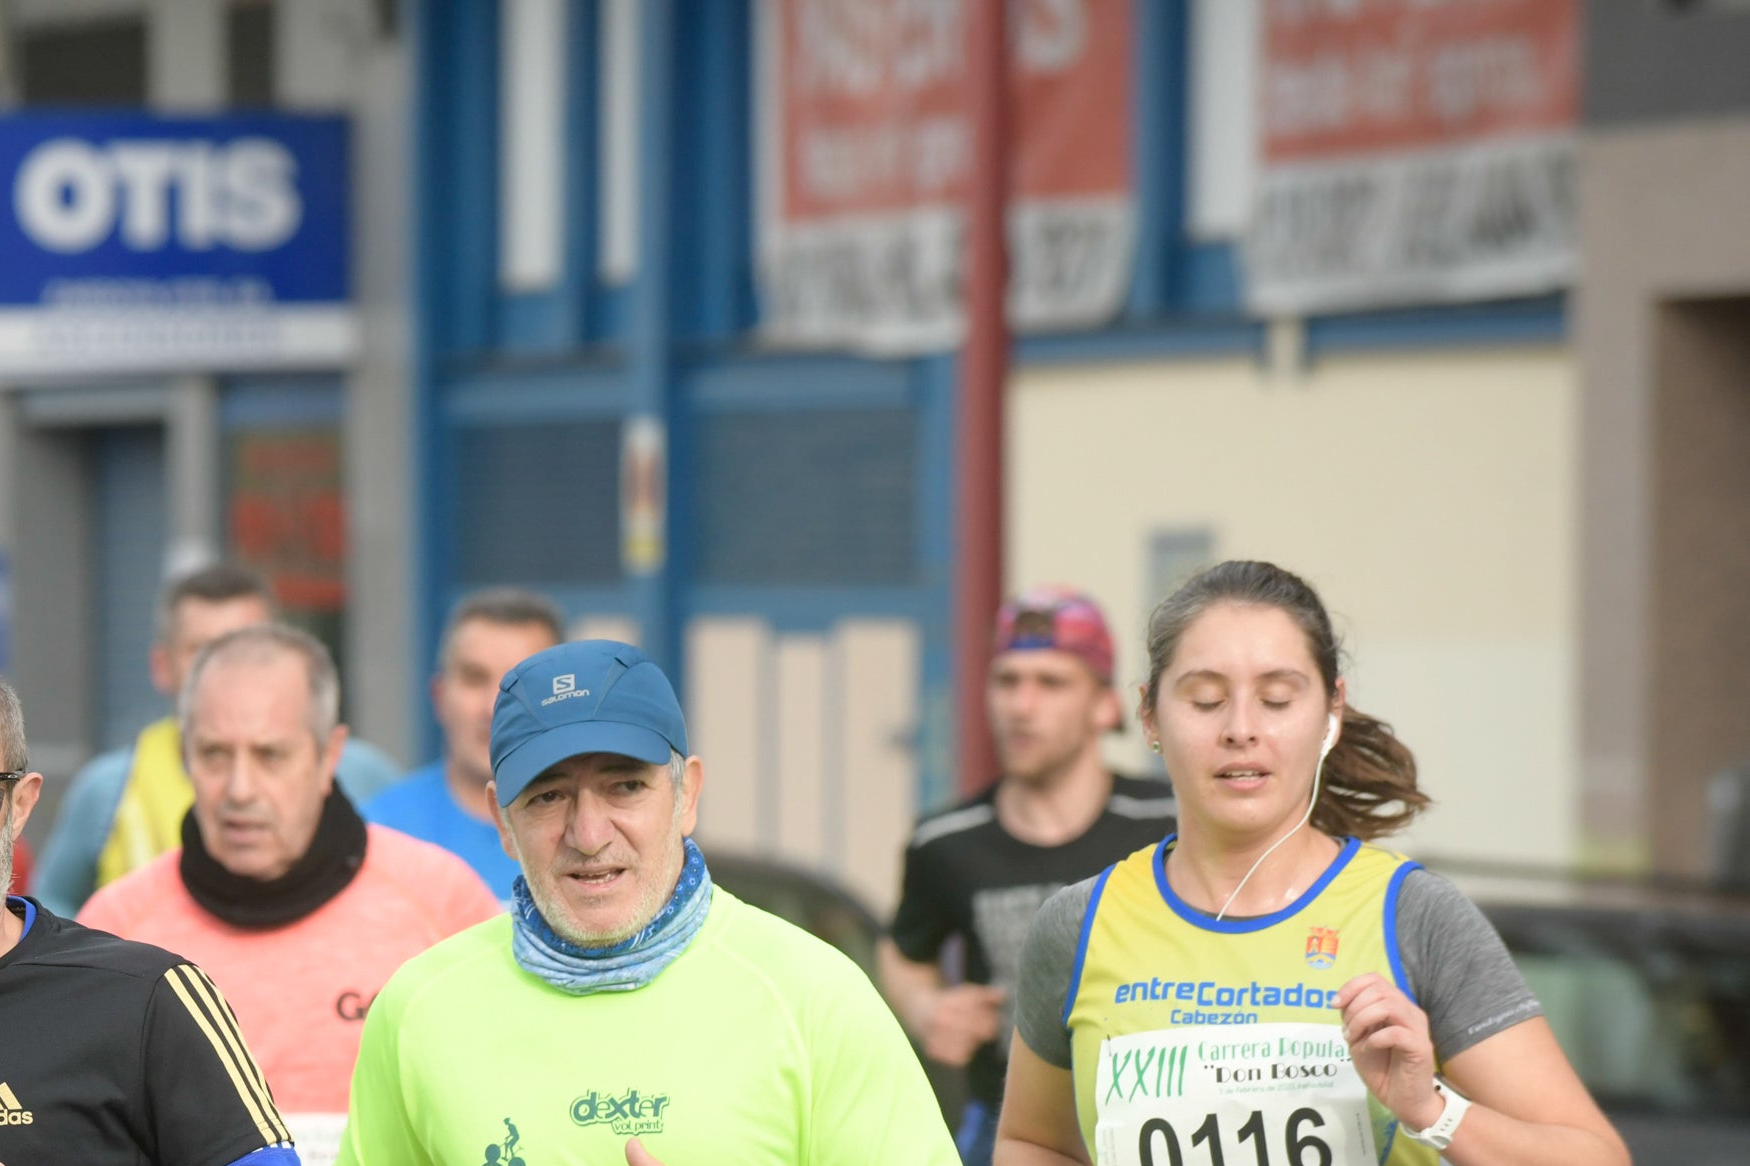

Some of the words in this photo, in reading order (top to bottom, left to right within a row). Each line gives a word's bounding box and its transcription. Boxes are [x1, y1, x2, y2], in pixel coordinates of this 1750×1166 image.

[13, 137, 302, 253] OTIS
[541, 689, 590, 707] salomon
[1115, 977, 1338, 1009] entreCortados
[1170, 1008, 1258, 1025] Cabezón
[1198, 1040, 1278, 1063] Carrera
[1105, 1045, 1188, 1106] XXIII
[573, 1089, 668, 1122] dexter
